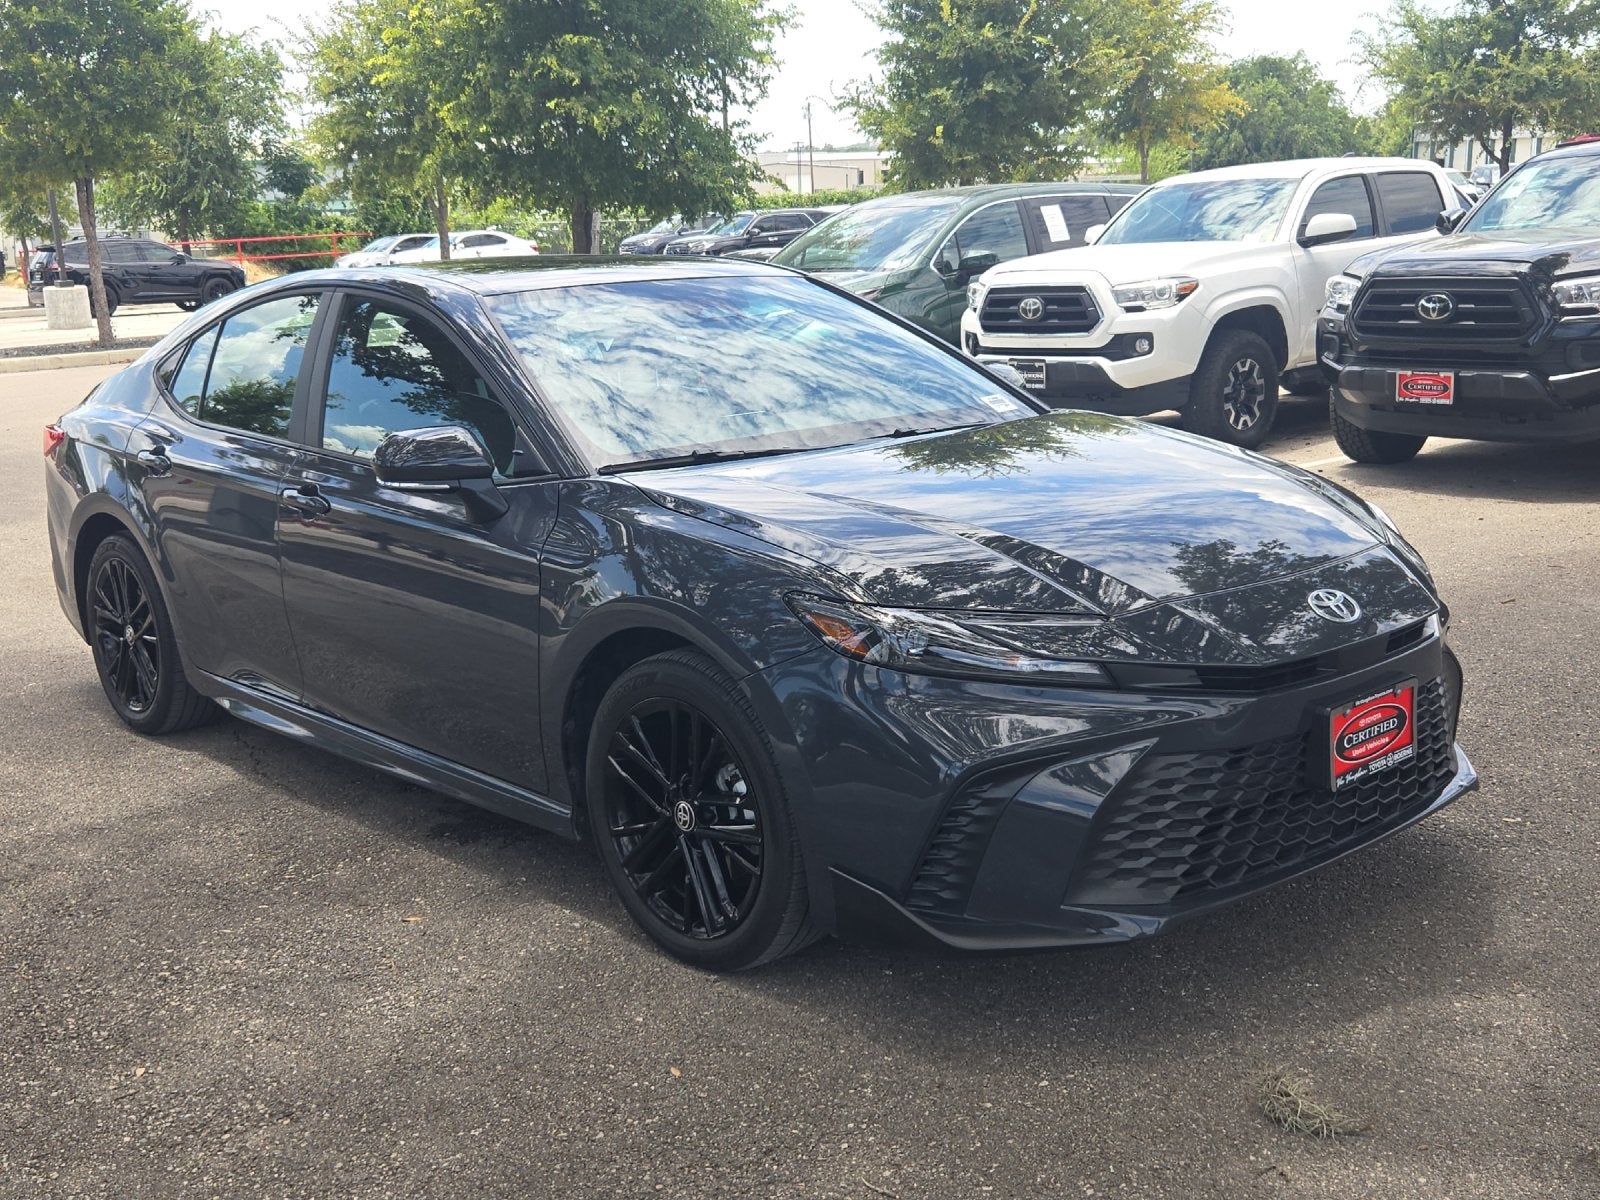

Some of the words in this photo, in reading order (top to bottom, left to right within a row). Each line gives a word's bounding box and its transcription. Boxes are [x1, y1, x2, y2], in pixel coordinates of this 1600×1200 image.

[1365, 713, 1382, 724] TOYOTA
[1344, 718, 1398, 748] CERTIFIED
[1352, 744, 1366, 757] Used
[1367, 736, 1389, 750] Vehicles
[1368, 759, 1387, 772] TOYOTA
